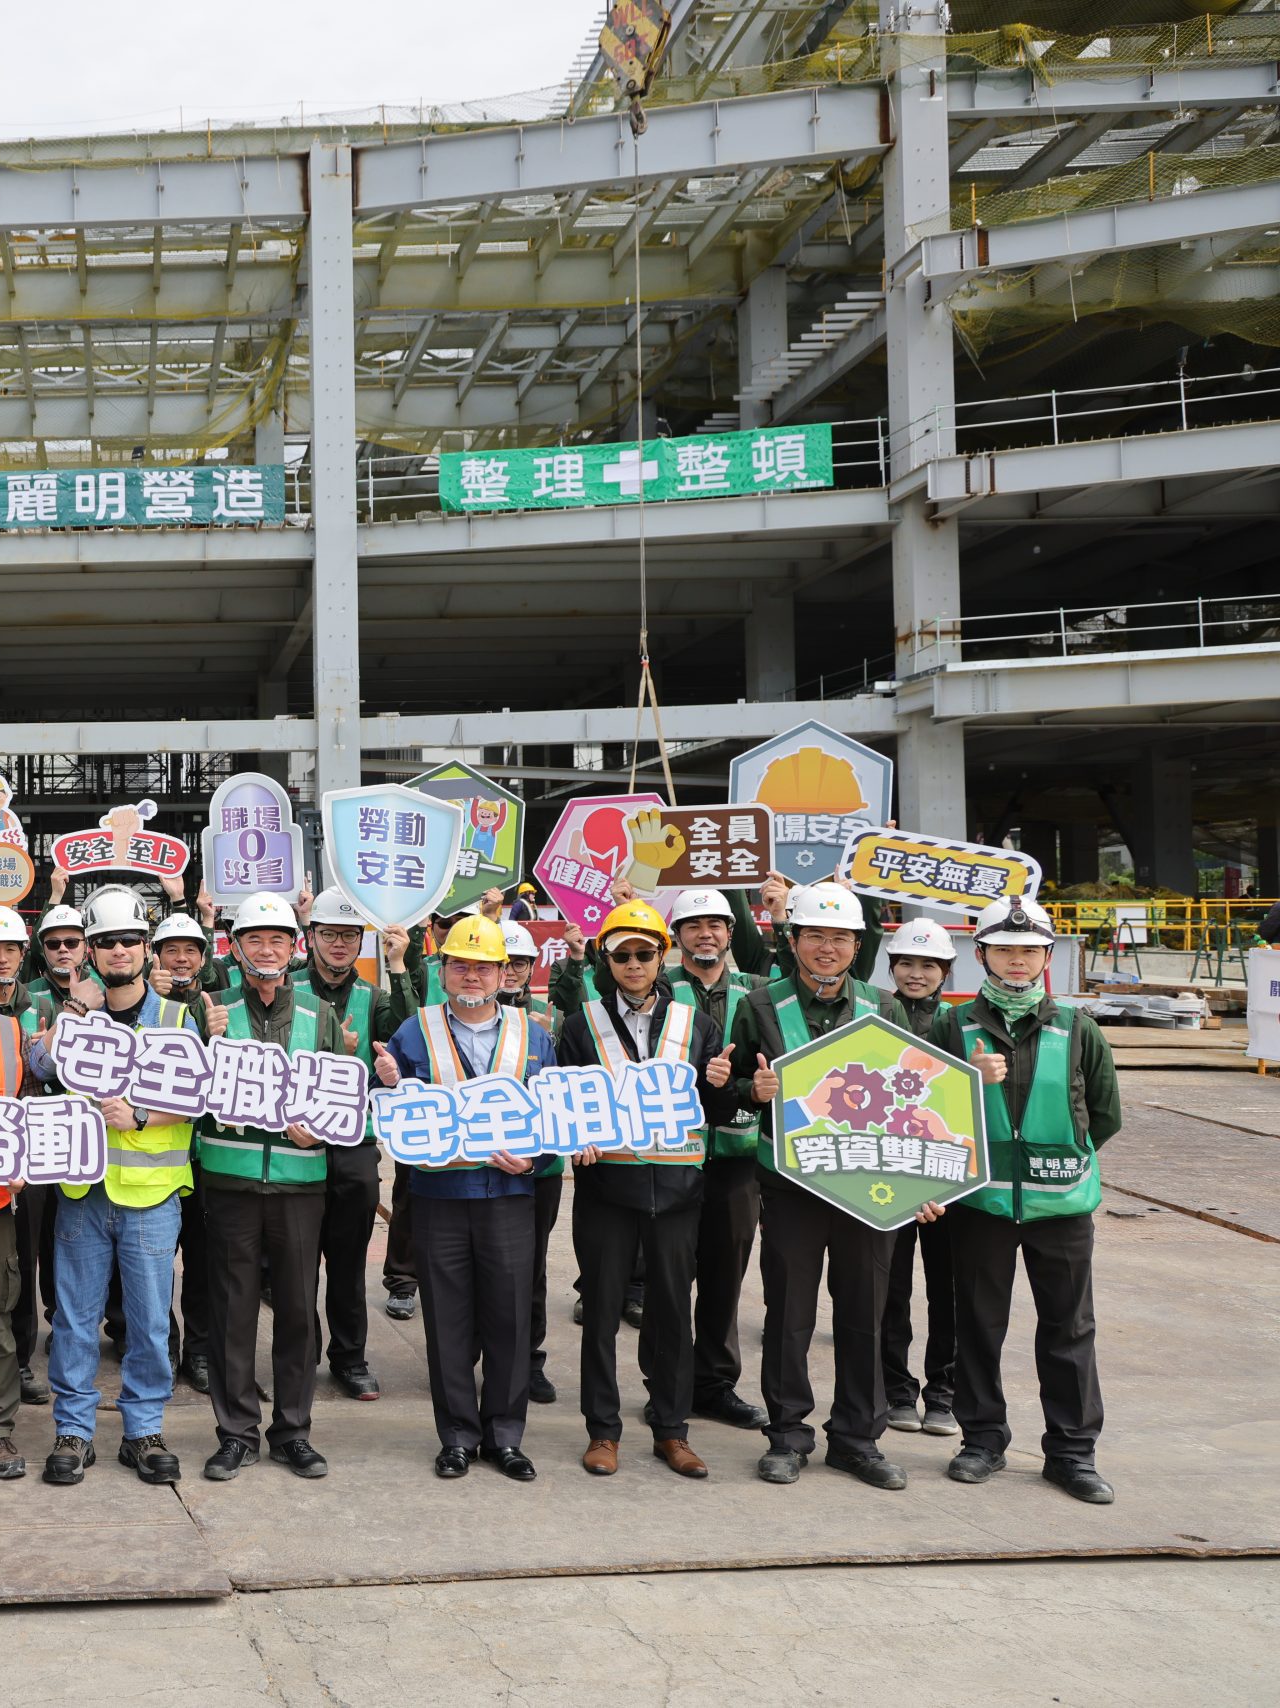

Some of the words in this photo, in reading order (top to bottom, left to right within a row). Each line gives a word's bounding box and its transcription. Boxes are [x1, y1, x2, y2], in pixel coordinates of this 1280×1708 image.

[460, 456, 586, 504] 整理
[677, 434, 808, 492] 整頓
[6, 469, 265, 523] 麗明營造
[220, 806, 281, 833] 職場
[357, 806, 427, 848] 勞動
[689, 814, 759, 847] 全員
[66, 837, 177, 870] 安全至上
[238, 829, 268, 862] 0
[689, 848, 760, 878] 安全
[223, 857, 285, 887] 災害
[356, 850, 426, 890] 安全
[870, 846, 1011, 900] 平安無憂
[57, 1017, 363, 1144] 安全職場
[377, 1063, 699, 1163] 安全相伴
[794, 1136, 969, 1183] 勞資雙贏
